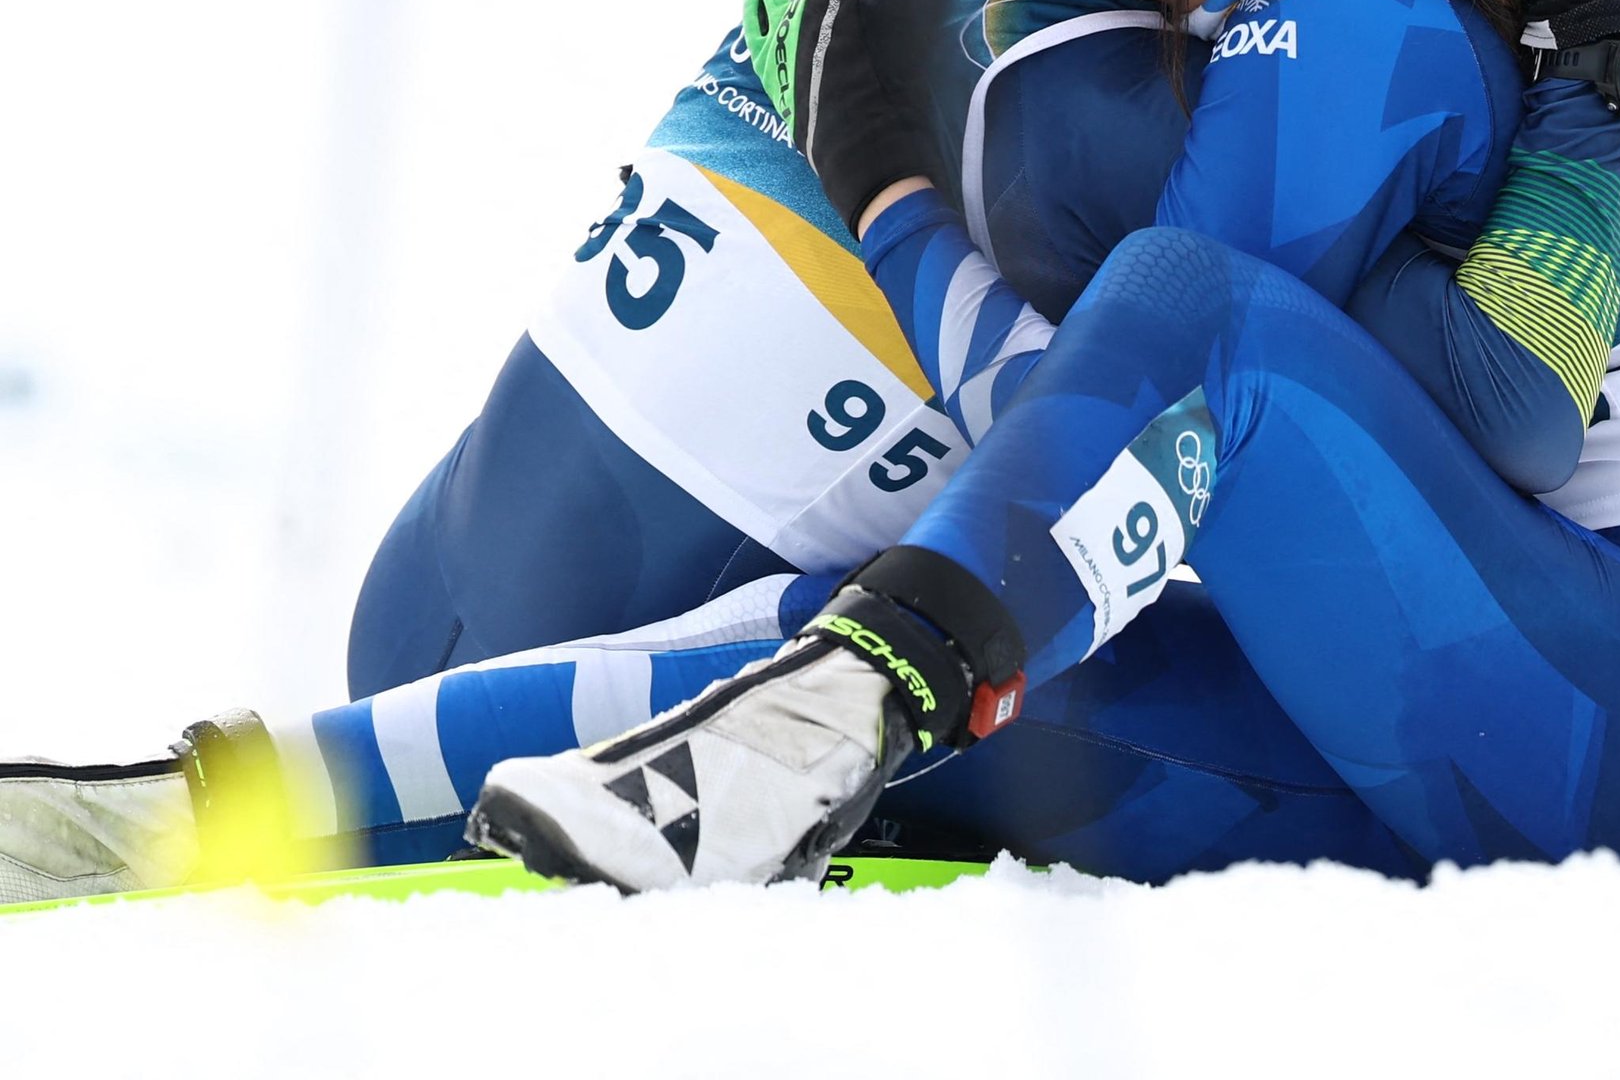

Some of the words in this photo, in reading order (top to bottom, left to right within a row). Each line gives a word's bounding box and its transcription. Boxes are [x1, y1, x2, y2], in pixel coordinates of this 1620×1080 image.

[718, 86, 794, 149] CORTINA
[806, 379, 951, 493] 95
[1069, 536, 1103, 584] MILANO
[1112, 501, 1167, 598] 97
